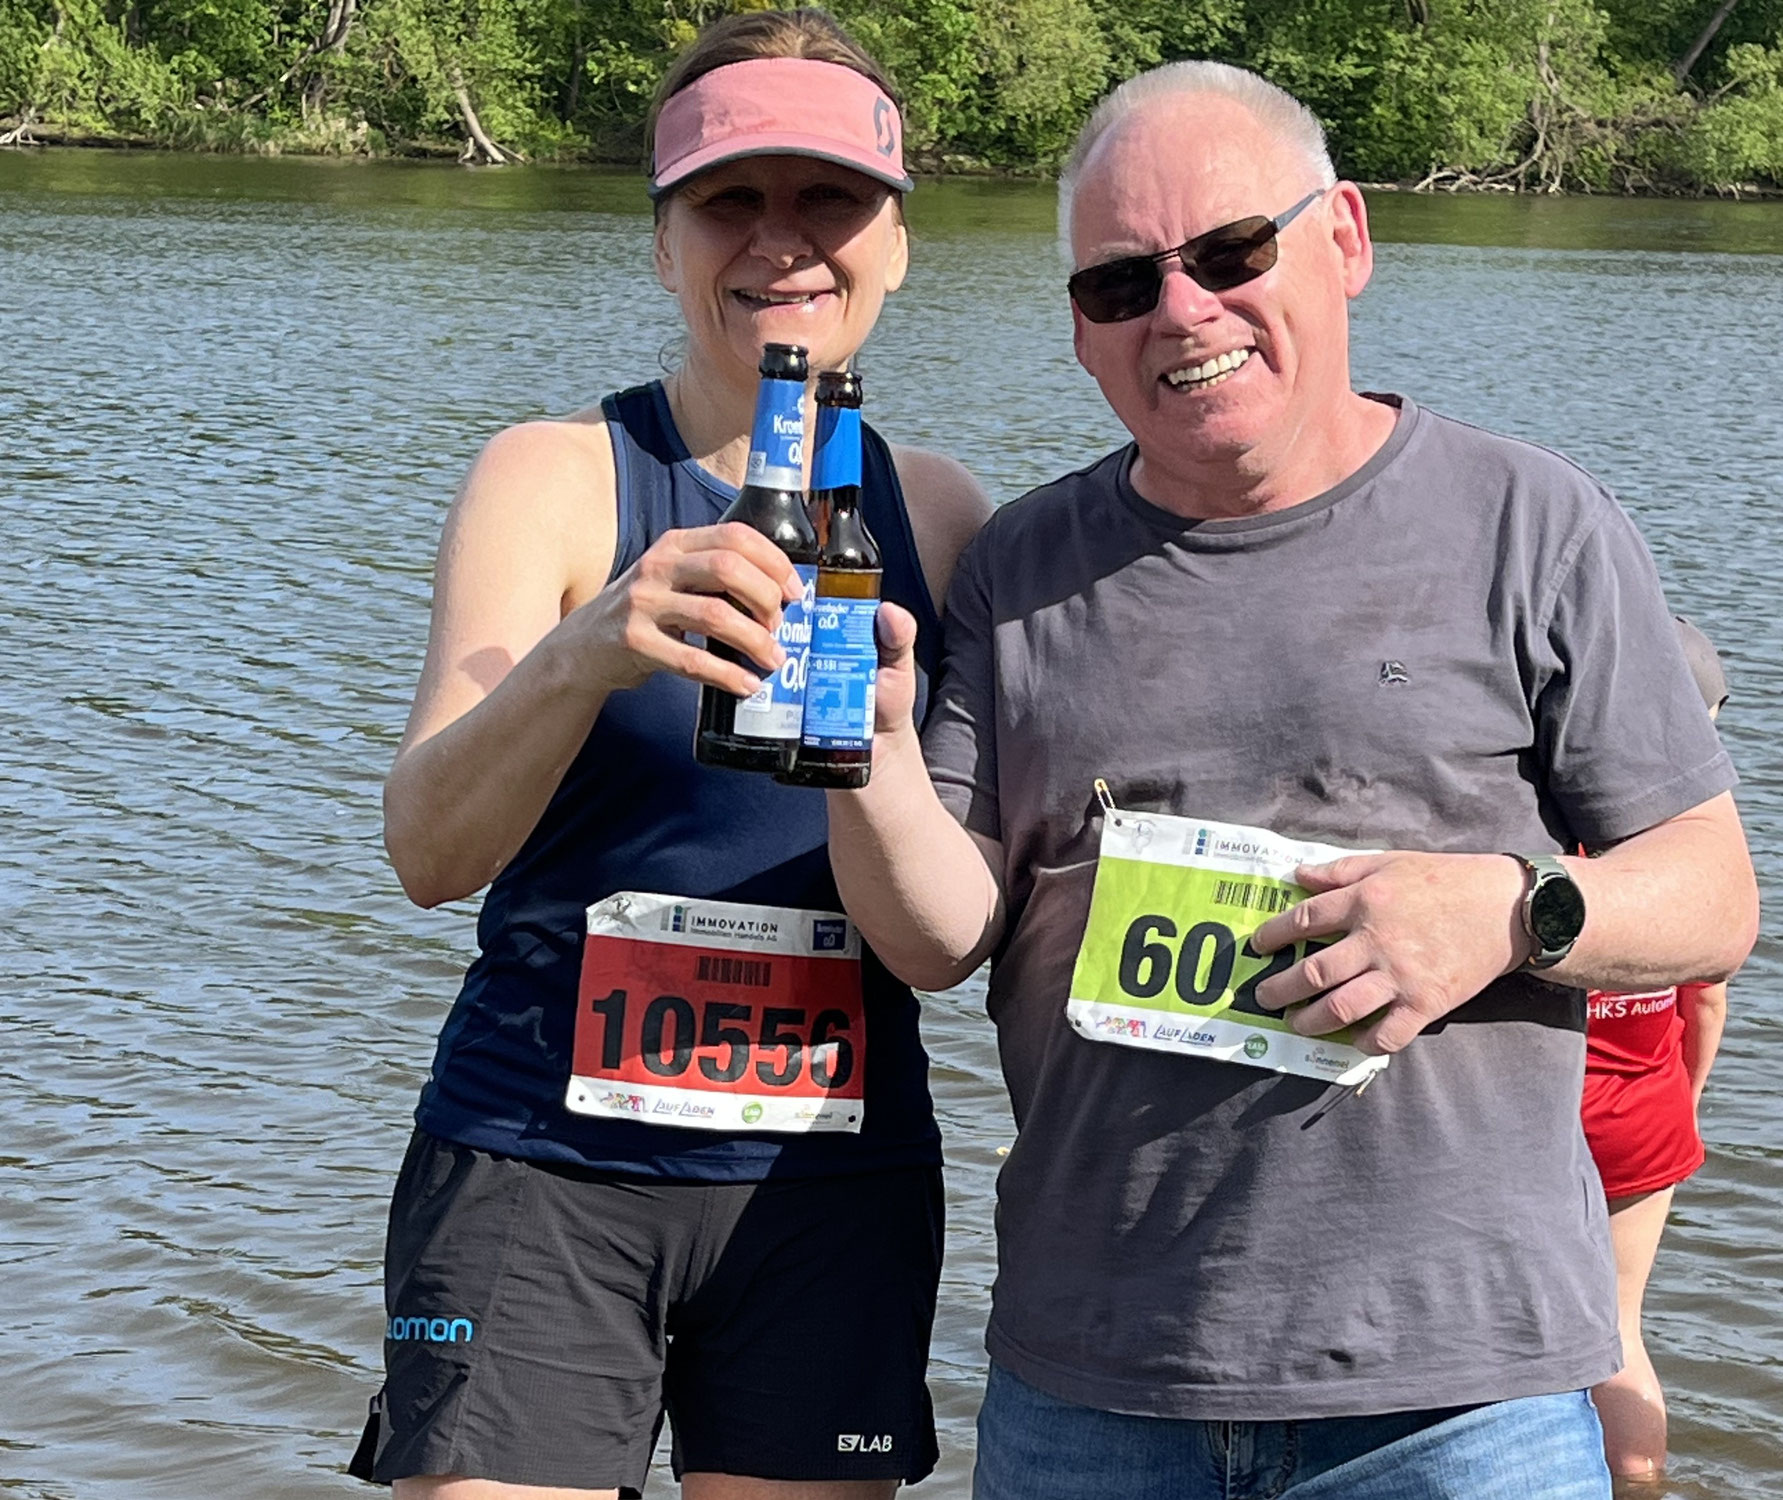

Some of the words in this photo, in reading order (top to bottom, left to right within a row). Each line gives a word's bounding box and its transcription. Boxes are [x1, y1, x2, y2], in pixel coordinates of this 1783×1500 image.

[691, 915, 778, 934] IMMOVATION
[1587, 1001, 1627, 1020] HKS
[592, 989, 854, 1089] 10556
